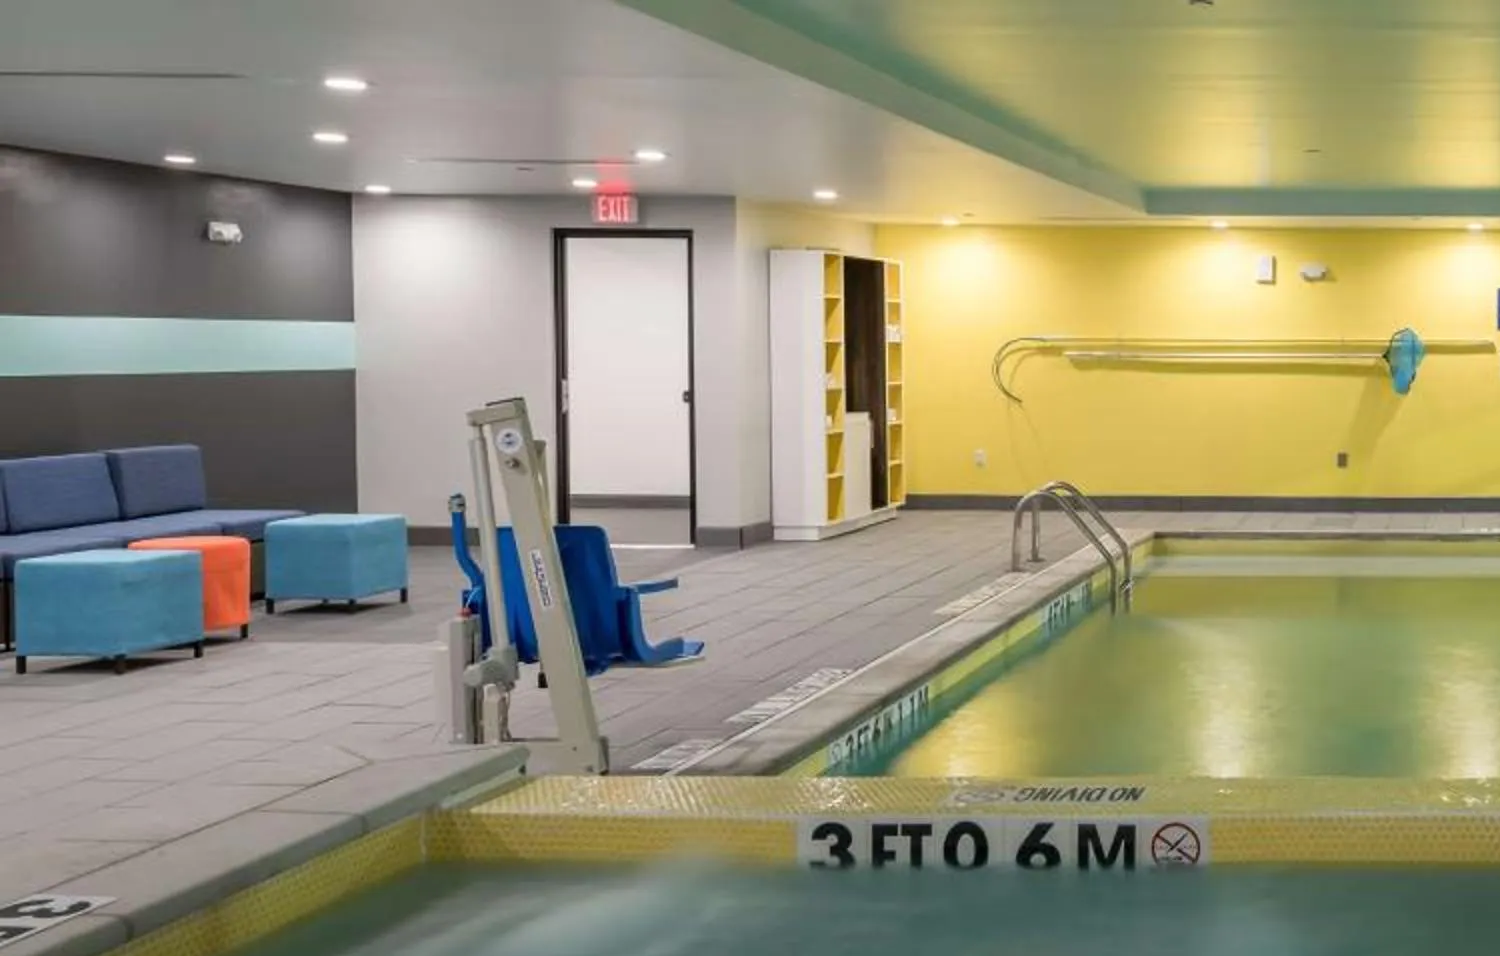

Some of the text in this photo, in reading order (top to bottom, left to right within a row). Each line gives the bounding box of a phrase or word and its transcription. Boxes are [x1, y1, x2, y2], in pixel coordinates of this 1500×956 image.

[598, 195, 629, 222] EXIT
[1014, 786, 1146, 803] NO DIVING
